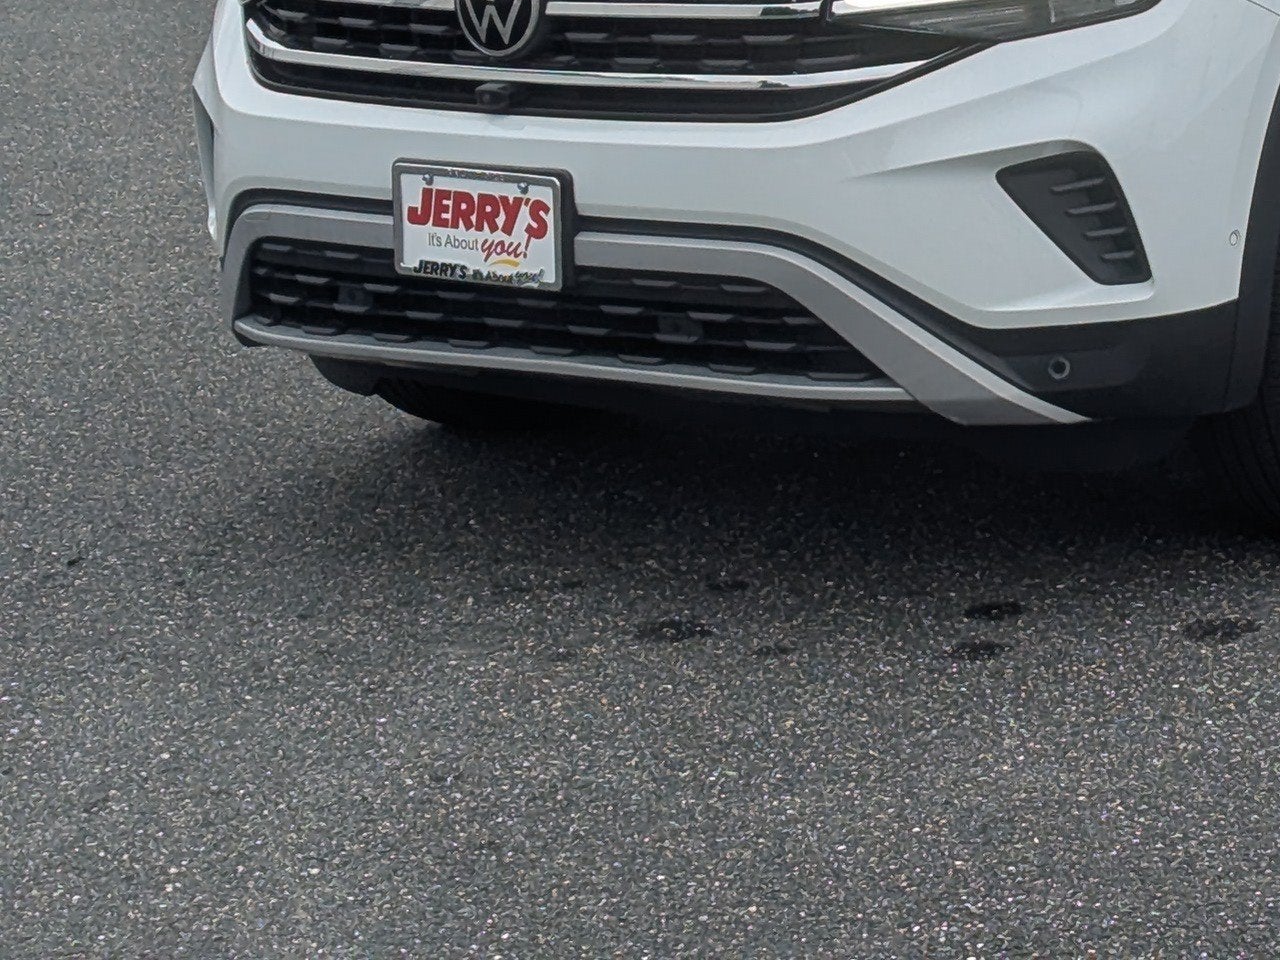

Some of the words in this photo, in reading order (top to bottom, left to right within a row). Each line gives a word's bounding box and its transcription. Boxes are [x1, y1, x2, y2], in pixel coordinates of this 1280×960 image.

[407, 187, 551, 240] JERRY'S
[428, 232, 442, 248] It's
[443, 234, 479, 251] About
[480, 235, 532, 263] you!
[413, 259, 468, 280] JERRY'S
